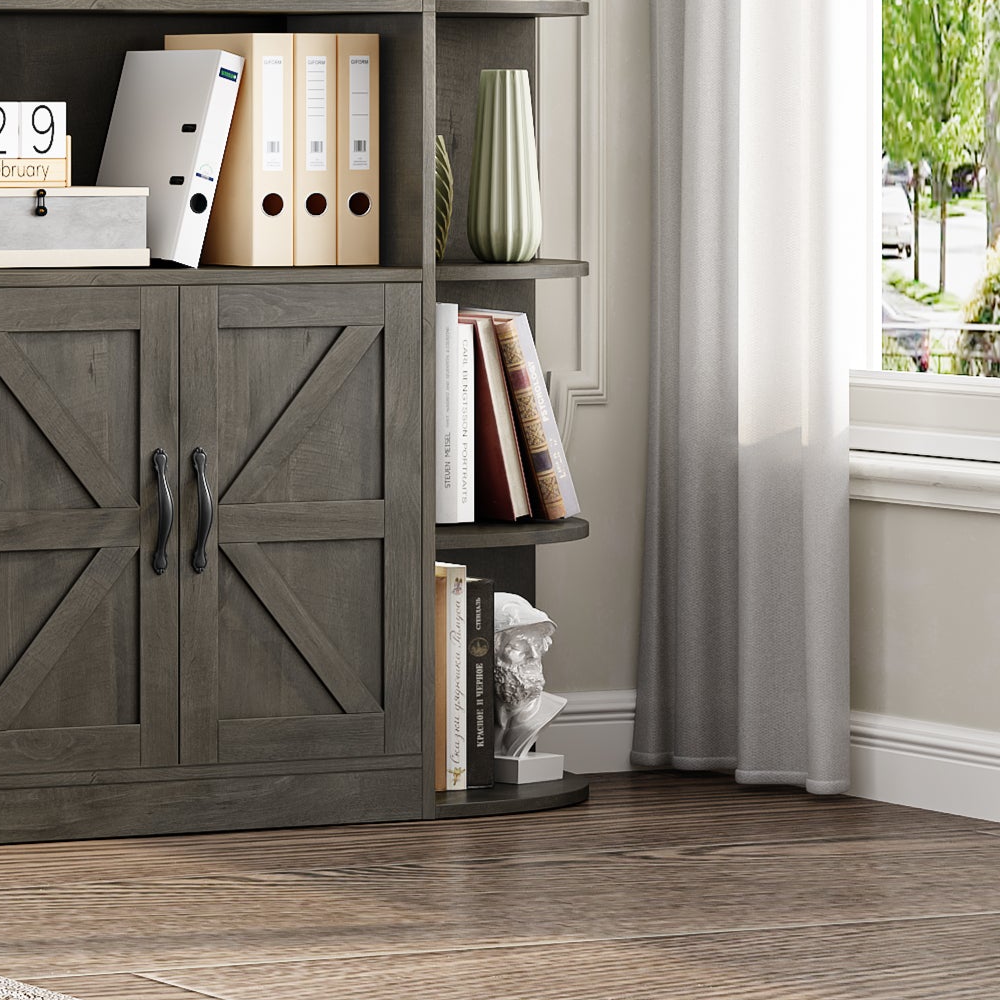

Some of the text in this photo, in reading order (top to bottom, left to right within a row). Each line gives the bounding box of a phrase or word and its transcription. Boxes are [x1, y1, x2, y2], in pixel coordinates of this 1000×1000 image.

[528, 361, 550, 422] PSYCHOLOGY
[475, 662, 484, 697] ЧЕРНОЕ
[476, 709, 485, 748] КРАСНОЕ
